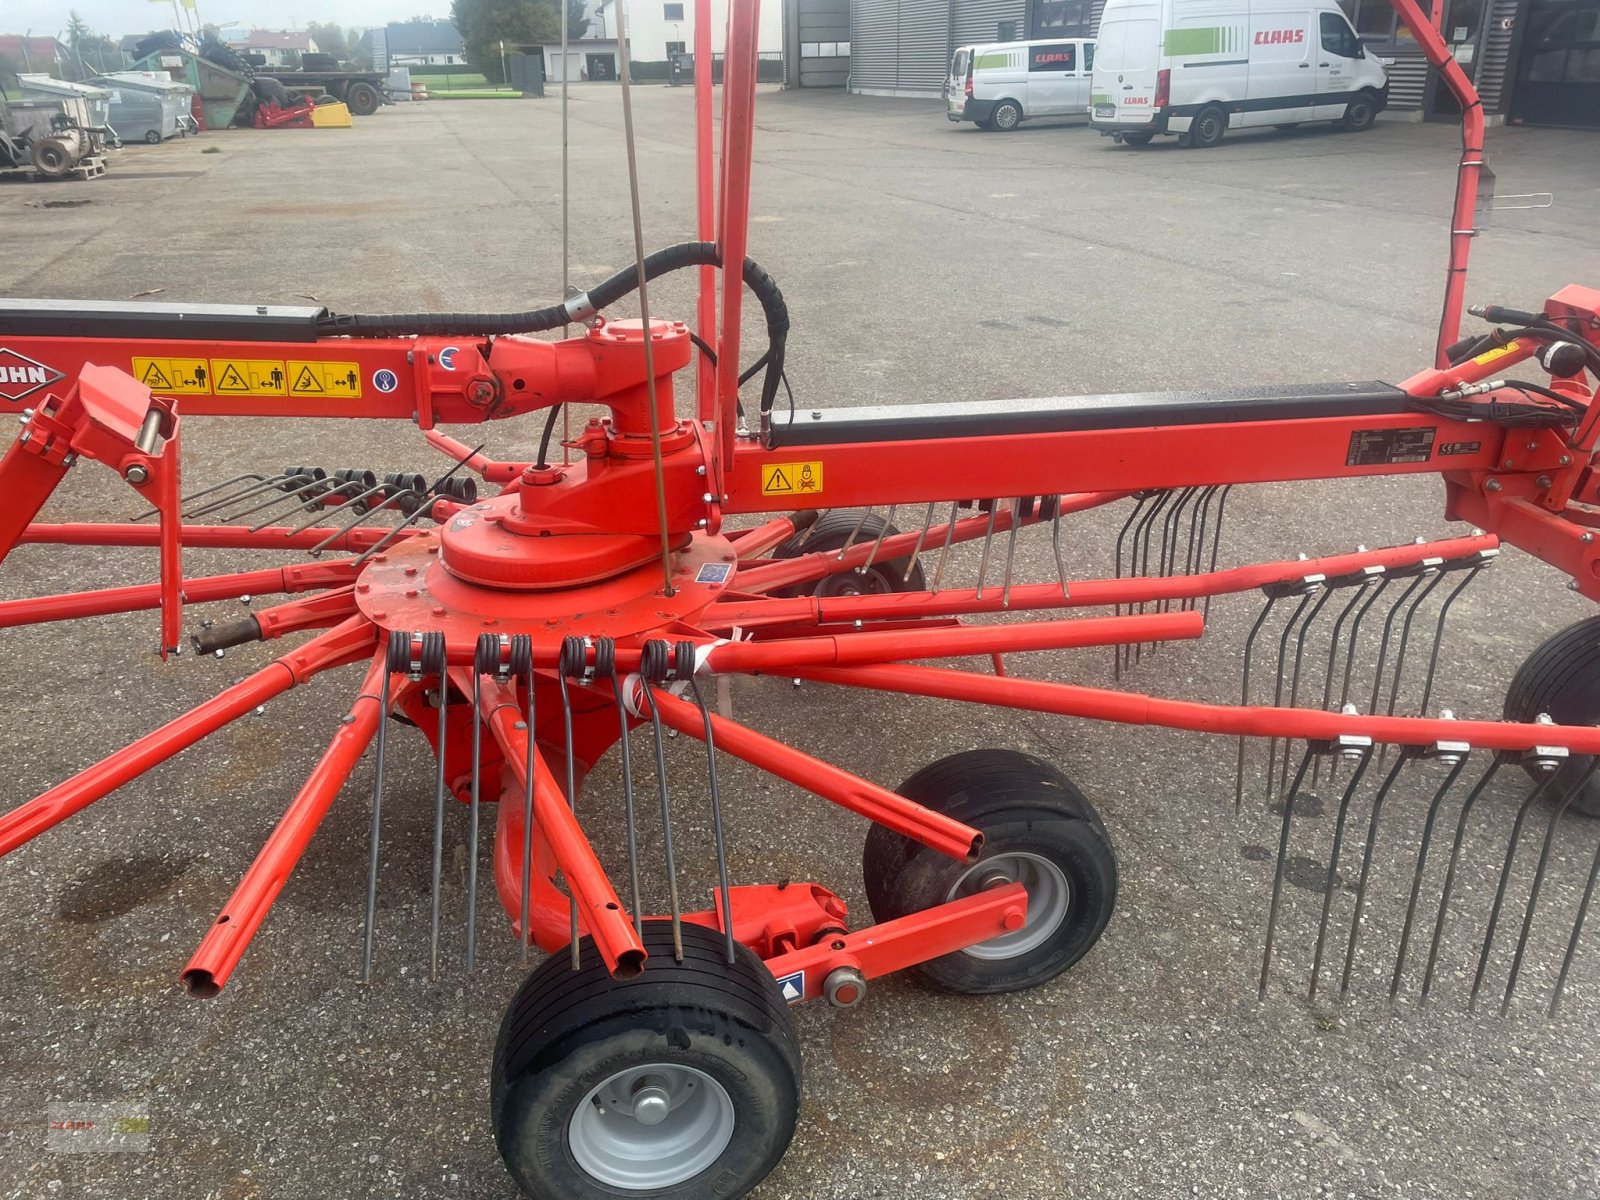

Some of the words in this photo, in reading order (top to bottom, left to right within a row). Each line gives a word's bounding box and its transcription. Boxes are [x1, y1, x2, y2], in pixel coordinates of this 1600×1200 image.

[1253, 29, 1304, 45] CLAAS
[1034, 53, 1071, 63] CLAAS
[1123, 97, 1149, 105] CLAAS
